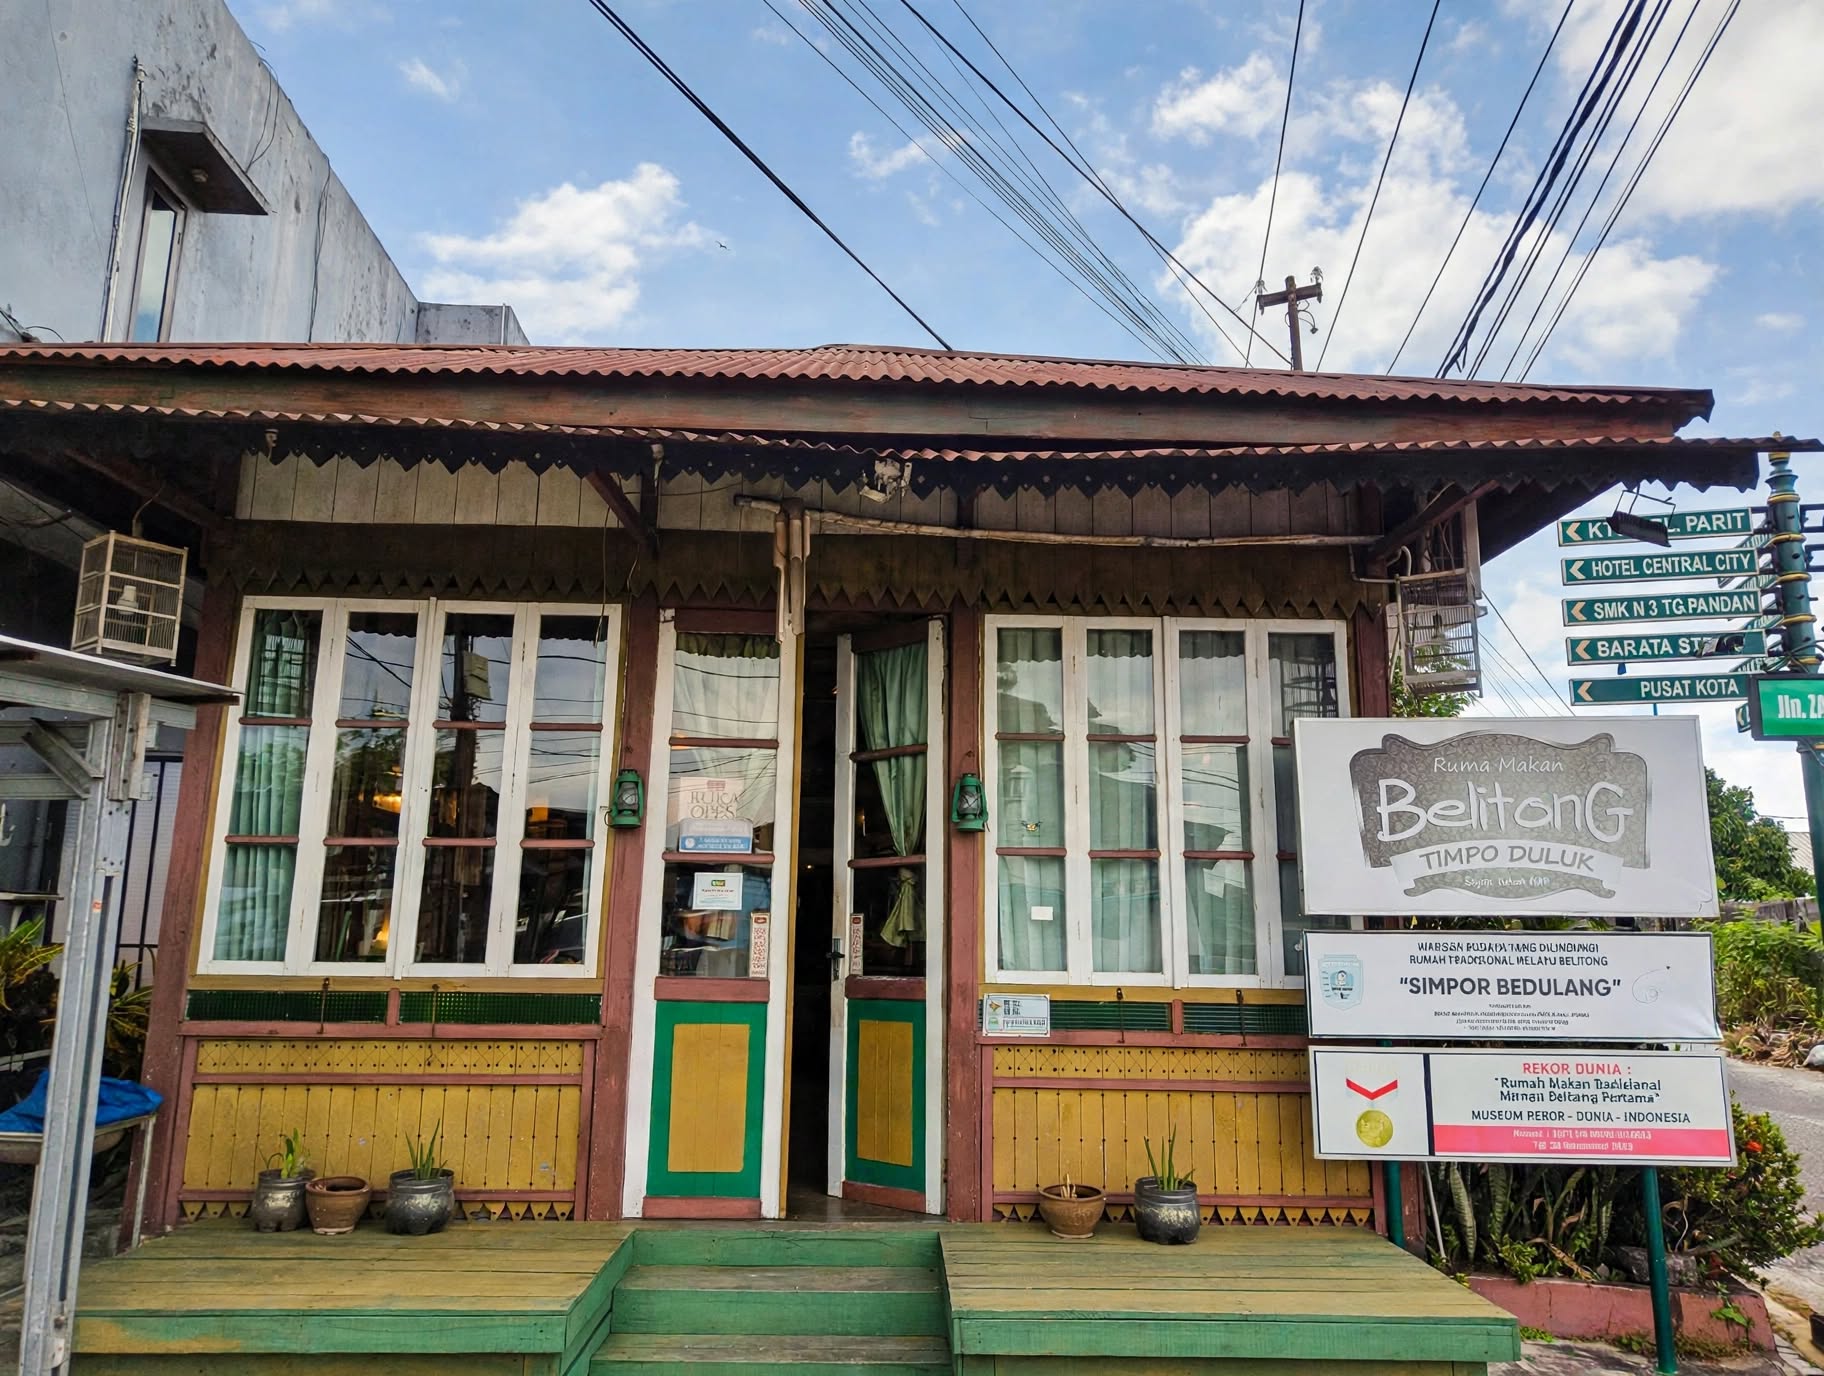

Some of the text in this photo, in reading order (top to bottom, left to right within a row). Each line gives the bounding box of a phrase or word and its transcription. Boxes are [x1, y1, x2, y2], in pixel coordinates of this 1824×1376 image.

[1686, 511, 1745, 533] PARIT
[1592, 553, 1751, 577] HOTEL CENTRAL CITY
[1594, 602, 1629, 619] SMK
[1633, 601, 1644, 617] N
[1649, 600, 1658, 617] 3
[1597, 638, 1673, 657] BARATA
[1640, 679, 1739, 697] PUSAT KOTA
[1434, 756, 1563, 773] Ruma Makan
[1419, 845, 1594, 872] TIMPO DULUK
[1410, 955, 1446, 965] RUMAH
[1400, 977, 1621, 997] "SIMPOR BEDULANG"
[1523, 1063, 1570, 1075] REKOR
[1575, 1063, 1622, 1075] DUNIA
[1472, 1110, 1523, 1121] MUSEUM
[1624, 1111, 1691, 1123] INDONESIA
